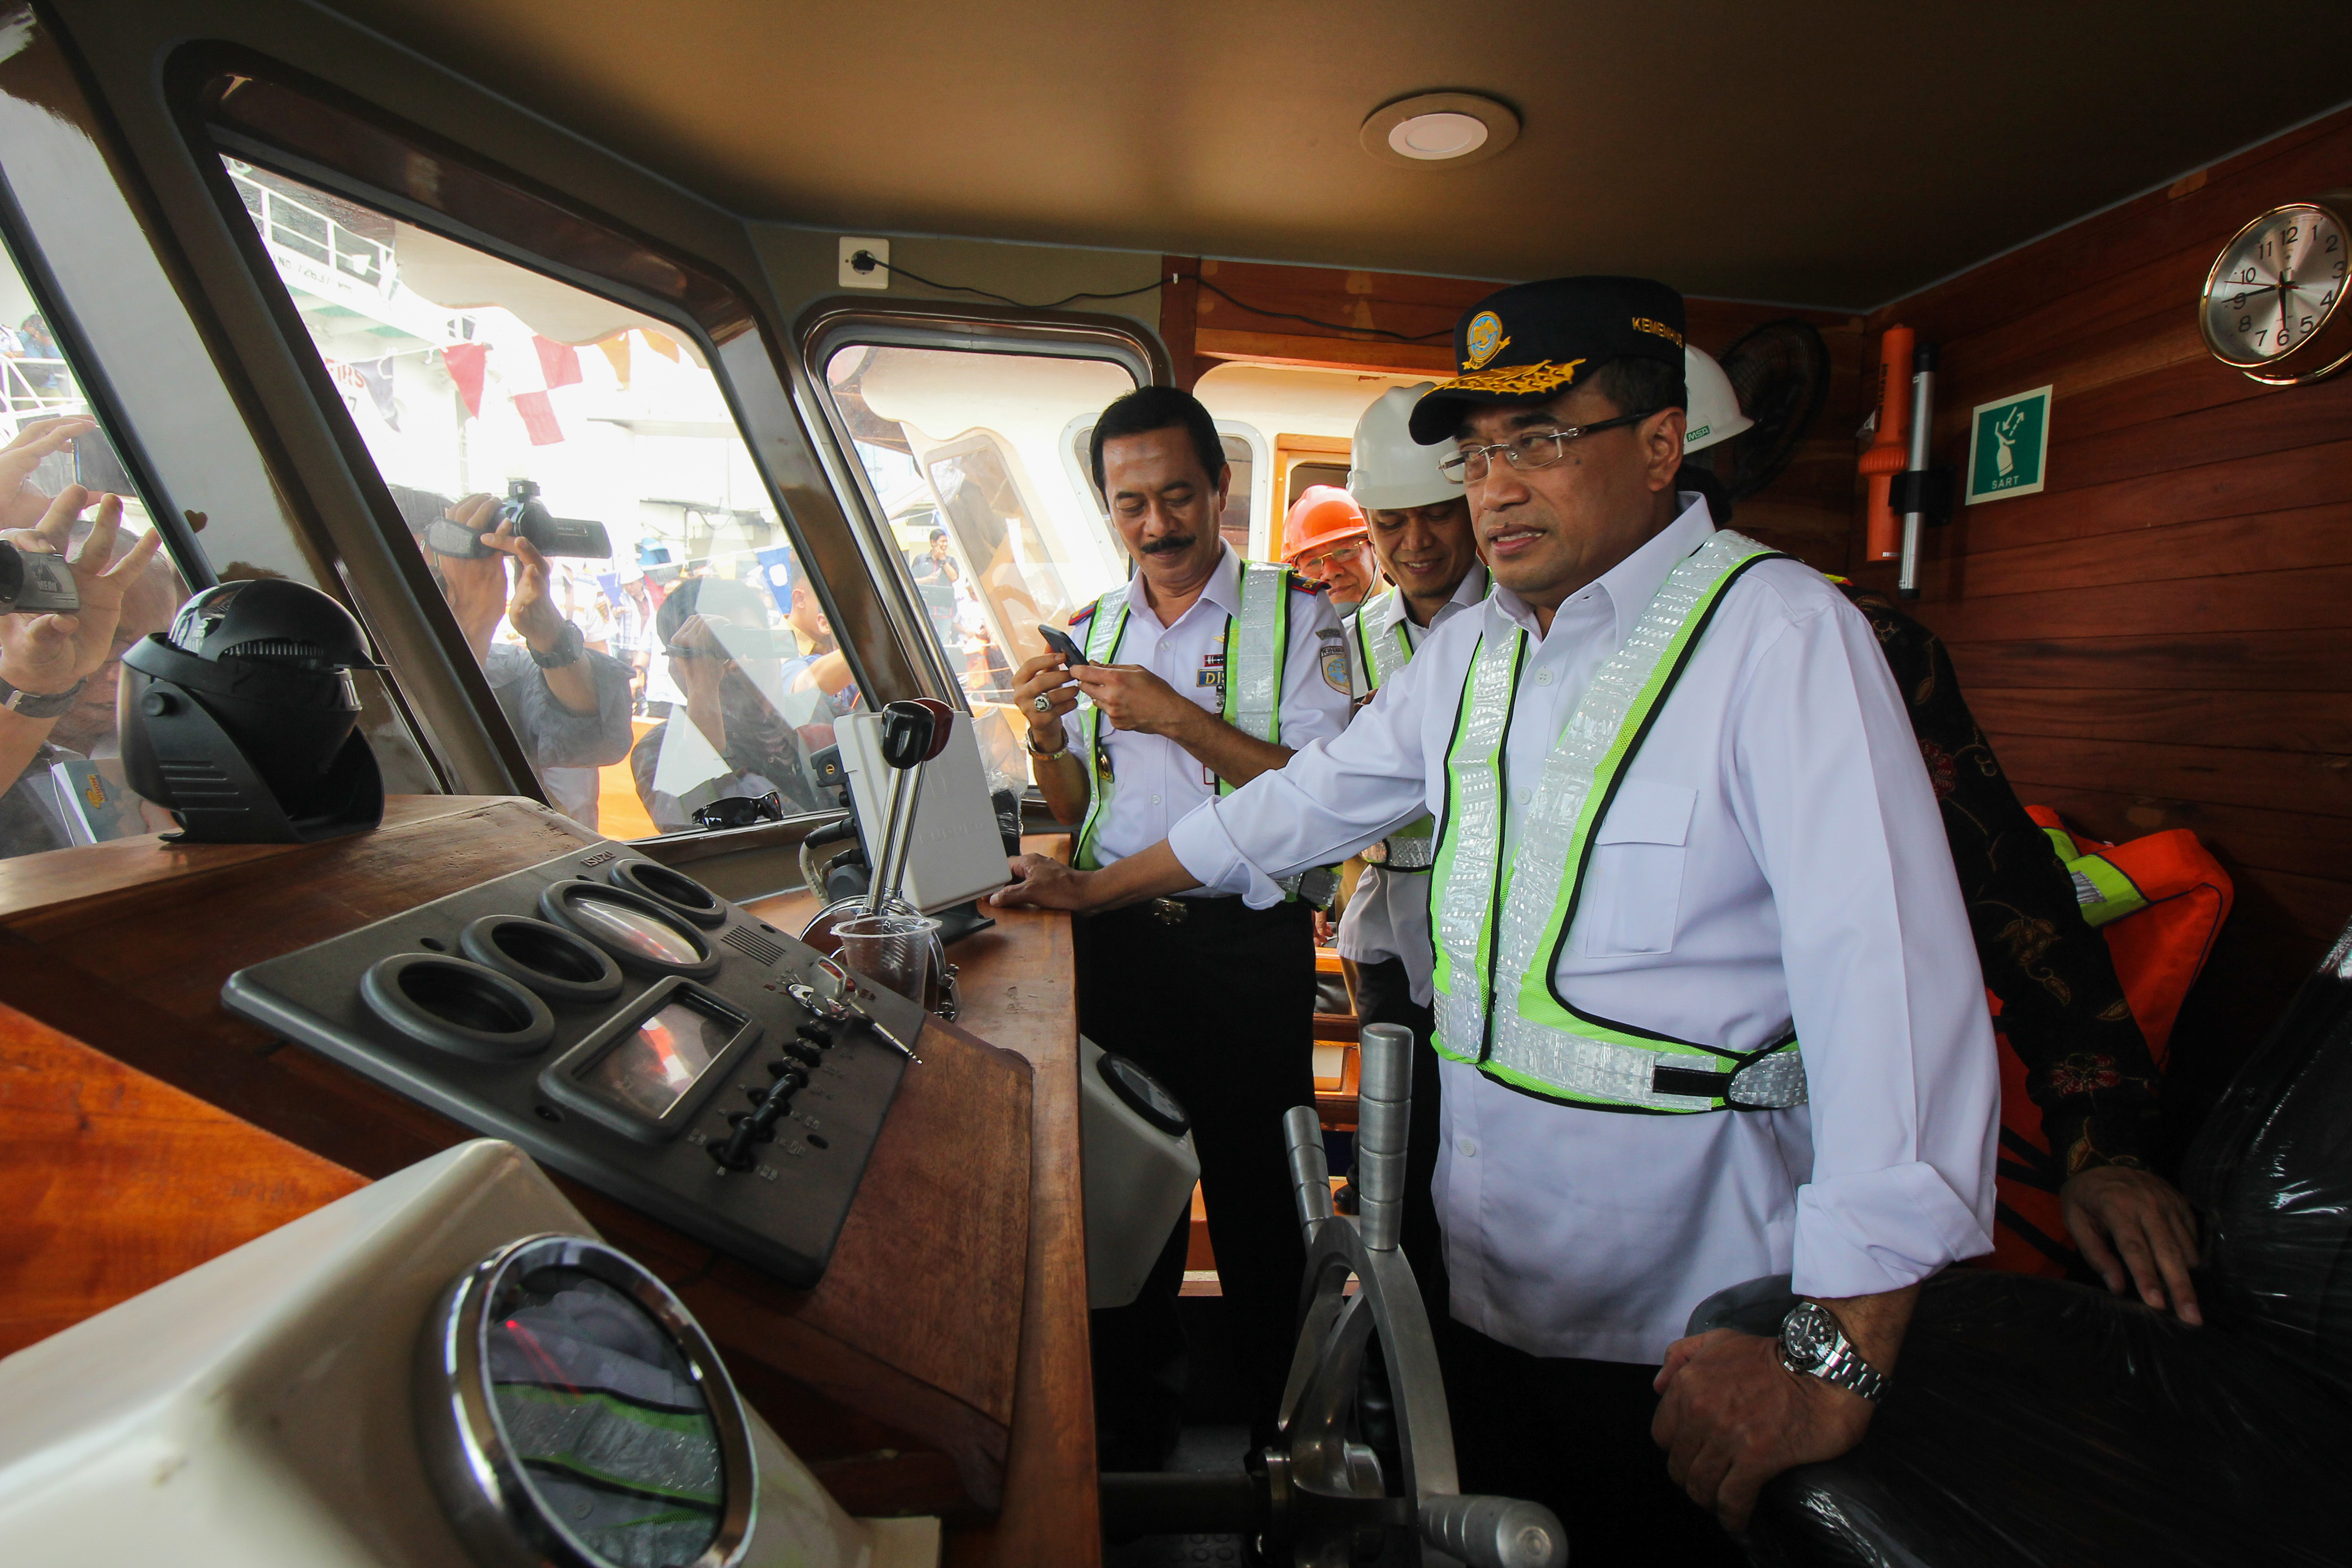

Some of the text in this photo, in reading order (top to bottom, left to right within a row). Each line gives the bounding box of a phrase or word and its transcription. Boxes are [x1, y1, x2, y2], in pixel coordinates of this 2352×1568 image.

[2281, 226, 2298, 246] 12
[2311, 225, 2318, 242] 1
[2259, 241, 2273, 260] 11
[2326, 235, 2338, 253] 2
[2240, 267, 2256, 285] 10
[2331, 260, 2346, 279] 3
[2233, 292, 2247, 310] 9
[2320, 290, 2334, 306] 4
[2239, 315, 2251, 332] 8
[2300, 316, 2314, 333] 5
[2255, 329, 2268, 347] 7
[2277, 327, 2290, 346] 6
[1688, 427, 1709, 441] MSA
[1991, 476, 2019, 489] SART
[581, 850, 616, 867] ISUZU
